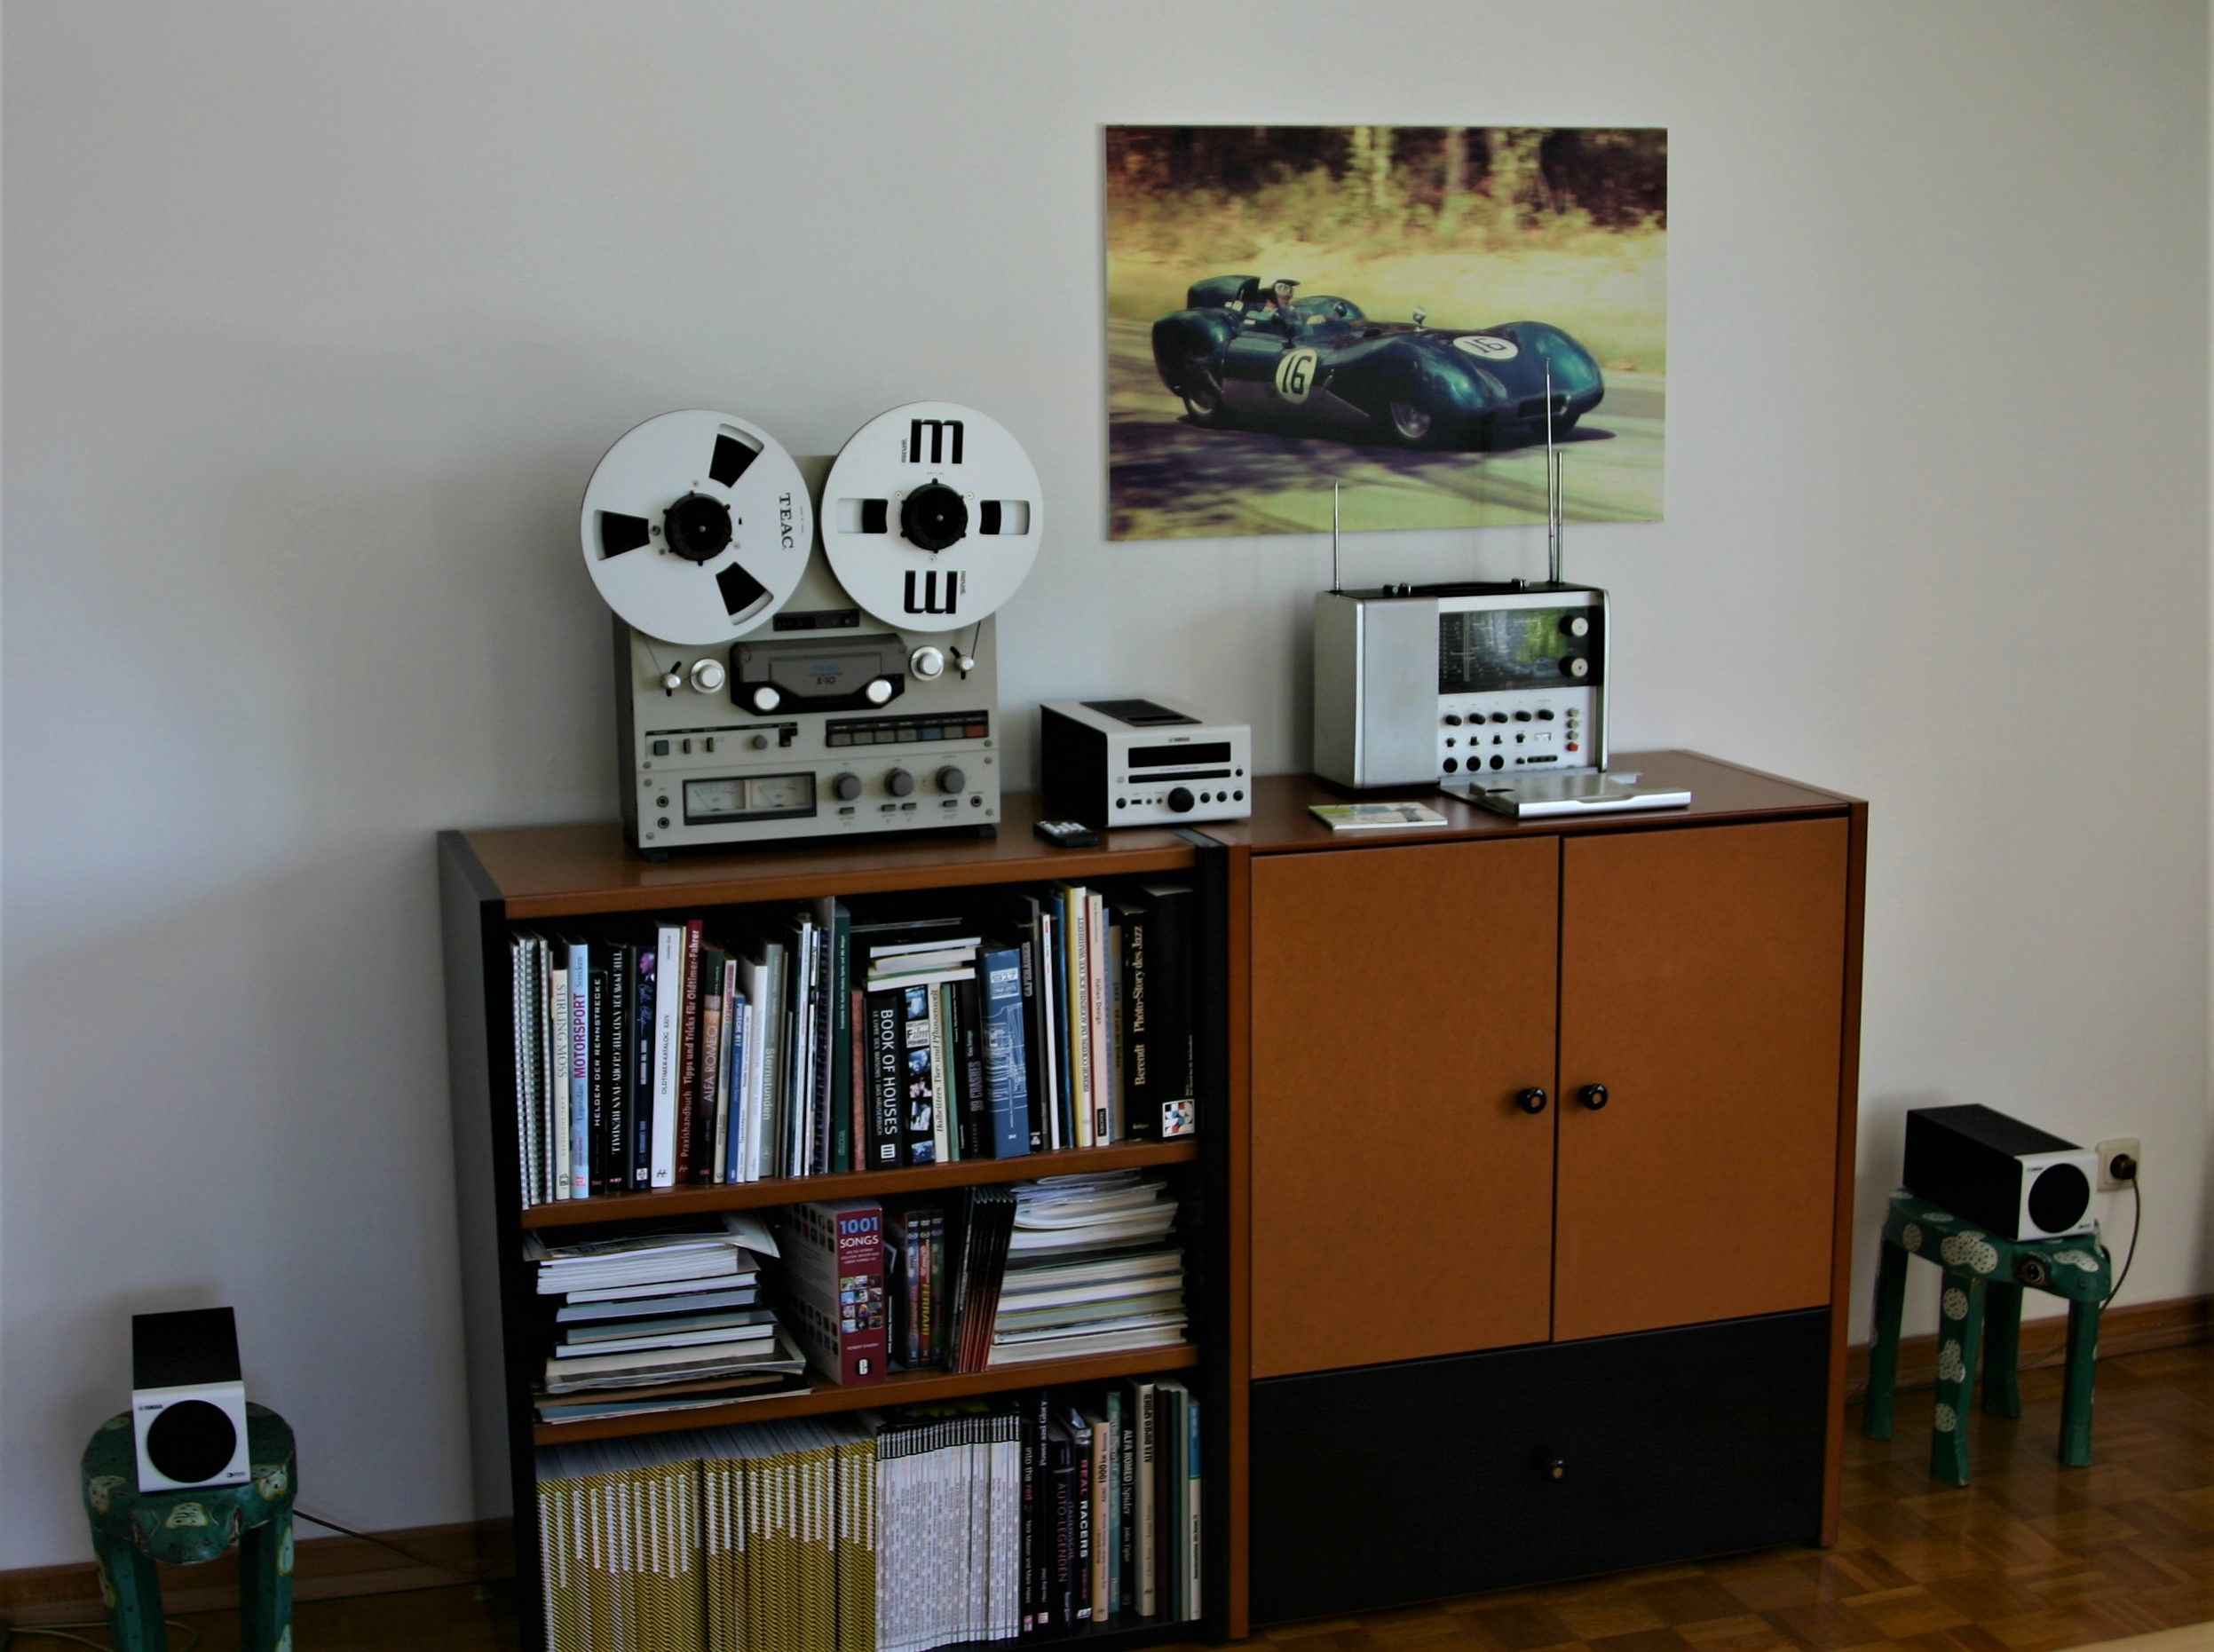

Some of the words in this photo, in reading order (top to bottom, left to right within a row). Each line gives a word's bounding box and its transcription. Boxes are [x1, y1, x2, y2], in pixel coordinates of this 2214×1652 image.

[1466, 336, 1507, 354] 16
[1281, 355, 1313, 396] 16
[779, 492, 795, 549] TEAC
[1132, 925, 1143, 950] Jazz
[612, 951, 621, 970] THE
[687, 929, 700, 1000] Oldtimer-Fahrer
[1133, 951, 1143, 969] des
[613, 971, 621, 1008] POWER
[1133, 970, 1146, 1033] Photo-Story
[557, 984, 566, 1039] STIRLING
[613, 1009, 621, 1028] AND
[686, 1002, 696, 1015] für
[930, 989, 941, 1044] Pflanzenwelt
[573, 992, 586, 1079] MOTORSPORT
[612, 1029, 621, 1052] THE
[685, 1016, 695, 1045] Tricks
[881, 1008, 895, 1051] BOOK
[557, 1041, 566, 1079] MOSS
[684, 1046, 693, 1061] und
[705, 1025, 718, 1072] ROMEO
[612, 1054, 621, 1081] GLORY
[684, 1063, 695, 1085] Tipps
[882, 1054, 895, 1072] OF
[1134, 1044, 1146, 1086] Berendt
[612, 1086, 621, 1109] IVAN
[702, 1075, 715, 1103] ALFA
[763, 1047, 776, 1121] Sternstunden
[883, 1077, 897, 1135] HOUSES
[935, 1087, 944, 1133] Halbritters
[612, 1111, 621, 1154] RENDALL
[681, 1091, 692, 1159] Praxishandbuch
[839, 1216, 880, 1236] 1001
[840, 1234, 880, 1249] SONGS
[1039, 1401, 1048, 1424] Glory
[1123, 1429, 1133, 1450] ALFA
[1024, 1446, 1033, 1465] into
[1039, 1443, 1048, 1466] Power
[1099, 1454, 1107, 1465] km
[1123, 1452, 1133, 1482] ROMEO
[1024, 1466, 1033, 1482] the
[1079, 1458, 1088, 1496] REAL
[1097, 1465, 1107, 1484] 1000
[1024, 1483, 1033, 1501] red
[1122, 1486, 1132, 1515] Spider
[1056, 1482, 1067, 1583] AUTO-LEGENDEN
[1079, 1499, 1089, 1558] RACERS
